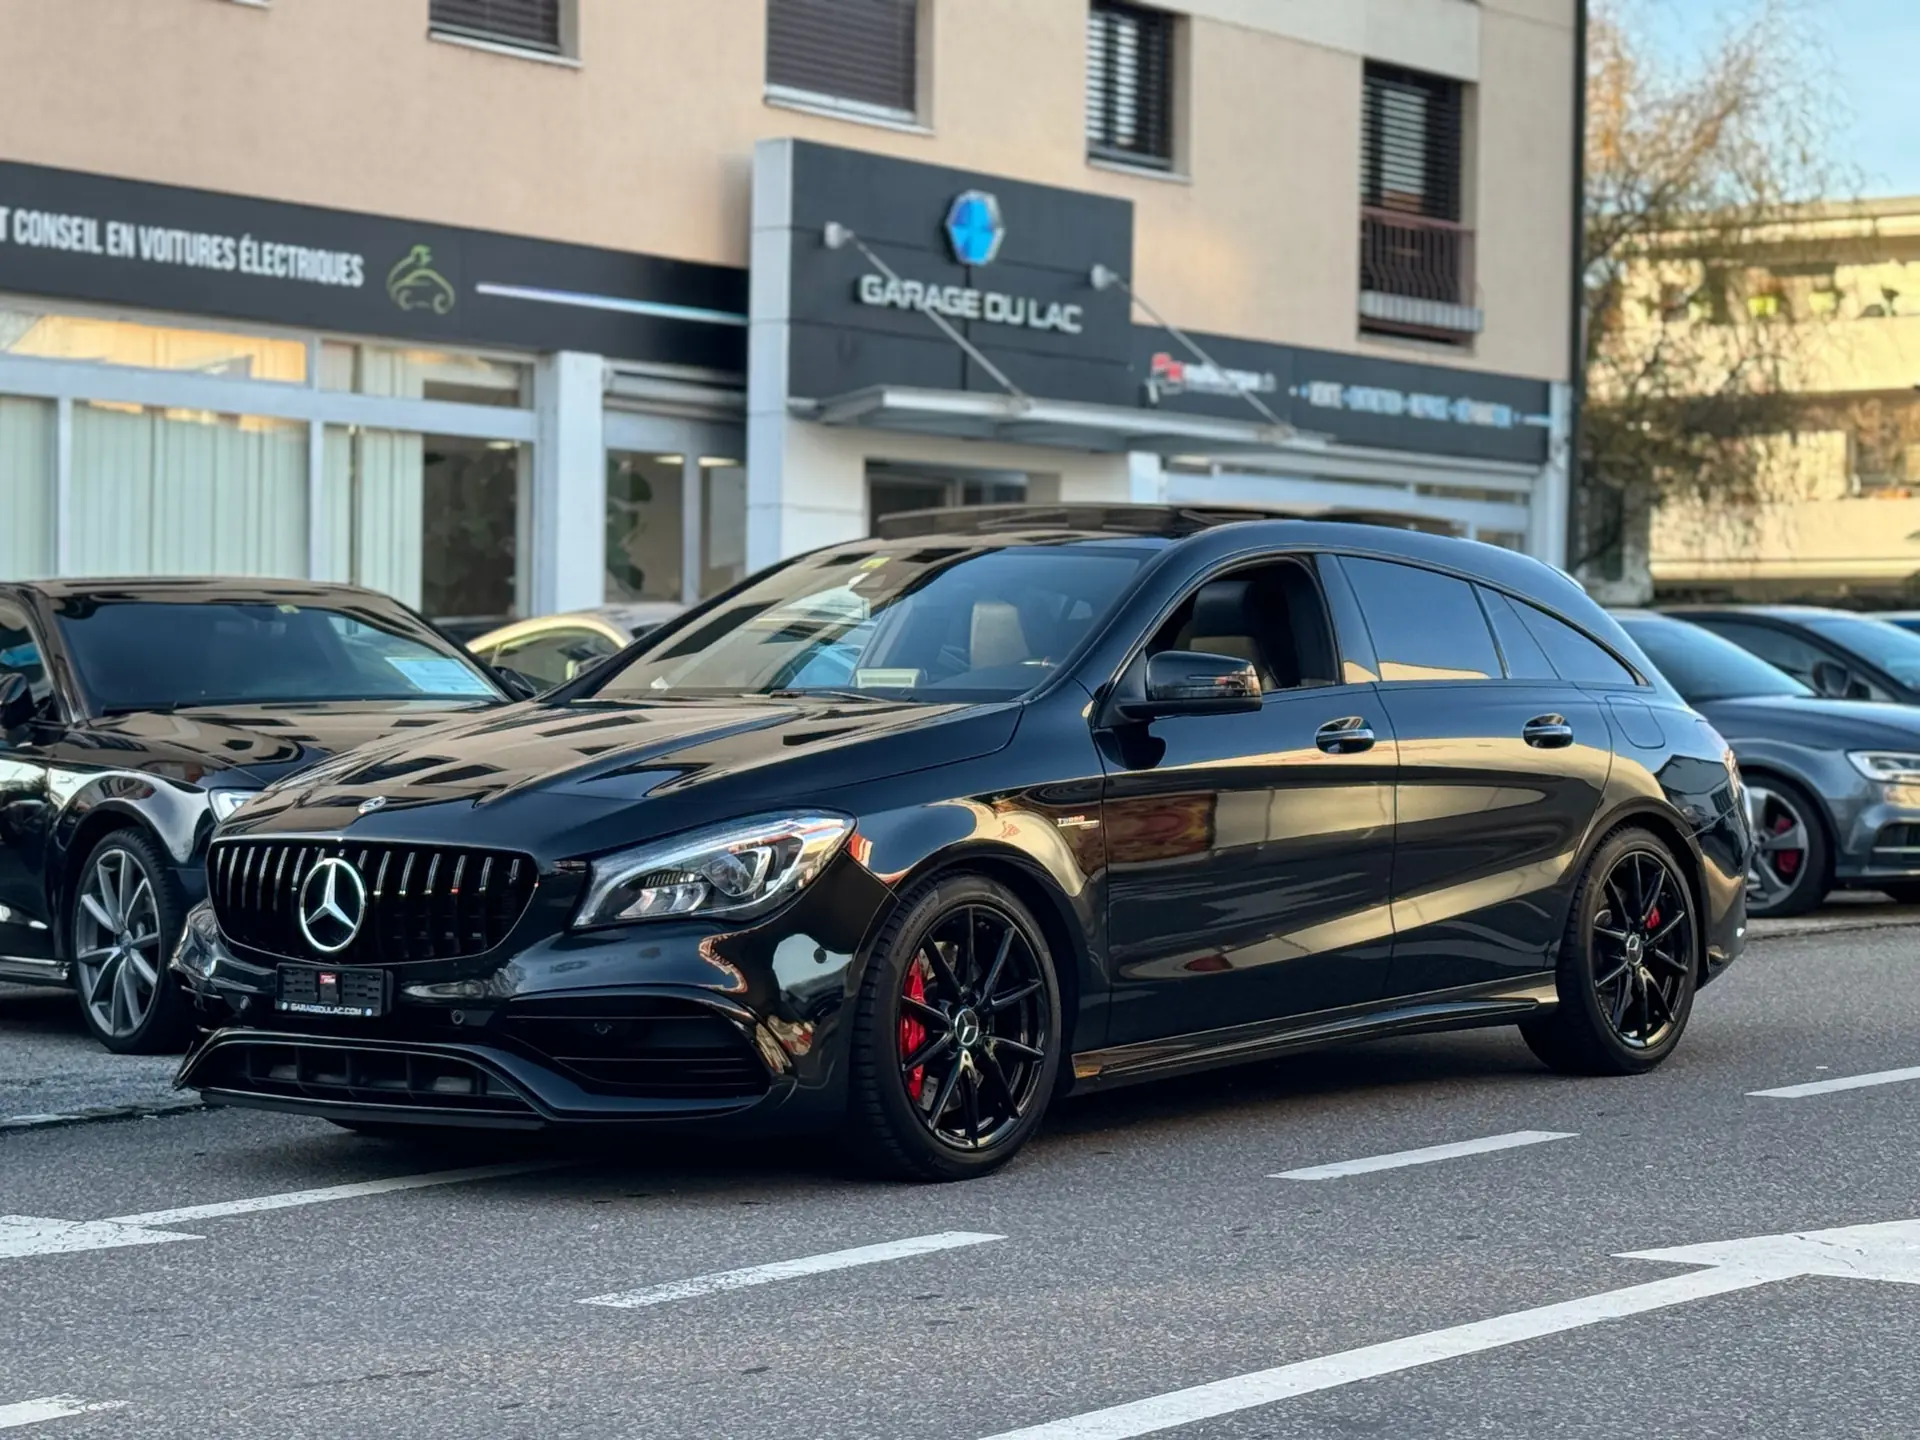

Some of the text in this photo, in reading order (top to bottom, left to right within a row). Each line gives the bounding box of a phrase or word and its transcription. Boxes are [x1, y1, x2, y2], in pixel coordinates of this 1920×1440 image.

[13, 208, 103, 254] CONSEIL
[106, 220, 136, 259] EN
[138, 225, 236, 272] VOITURES
[239, 233, 364, 288] ÉLECTRIQUES
[860, 274, 1083, 335] GARAGE DU LAC
